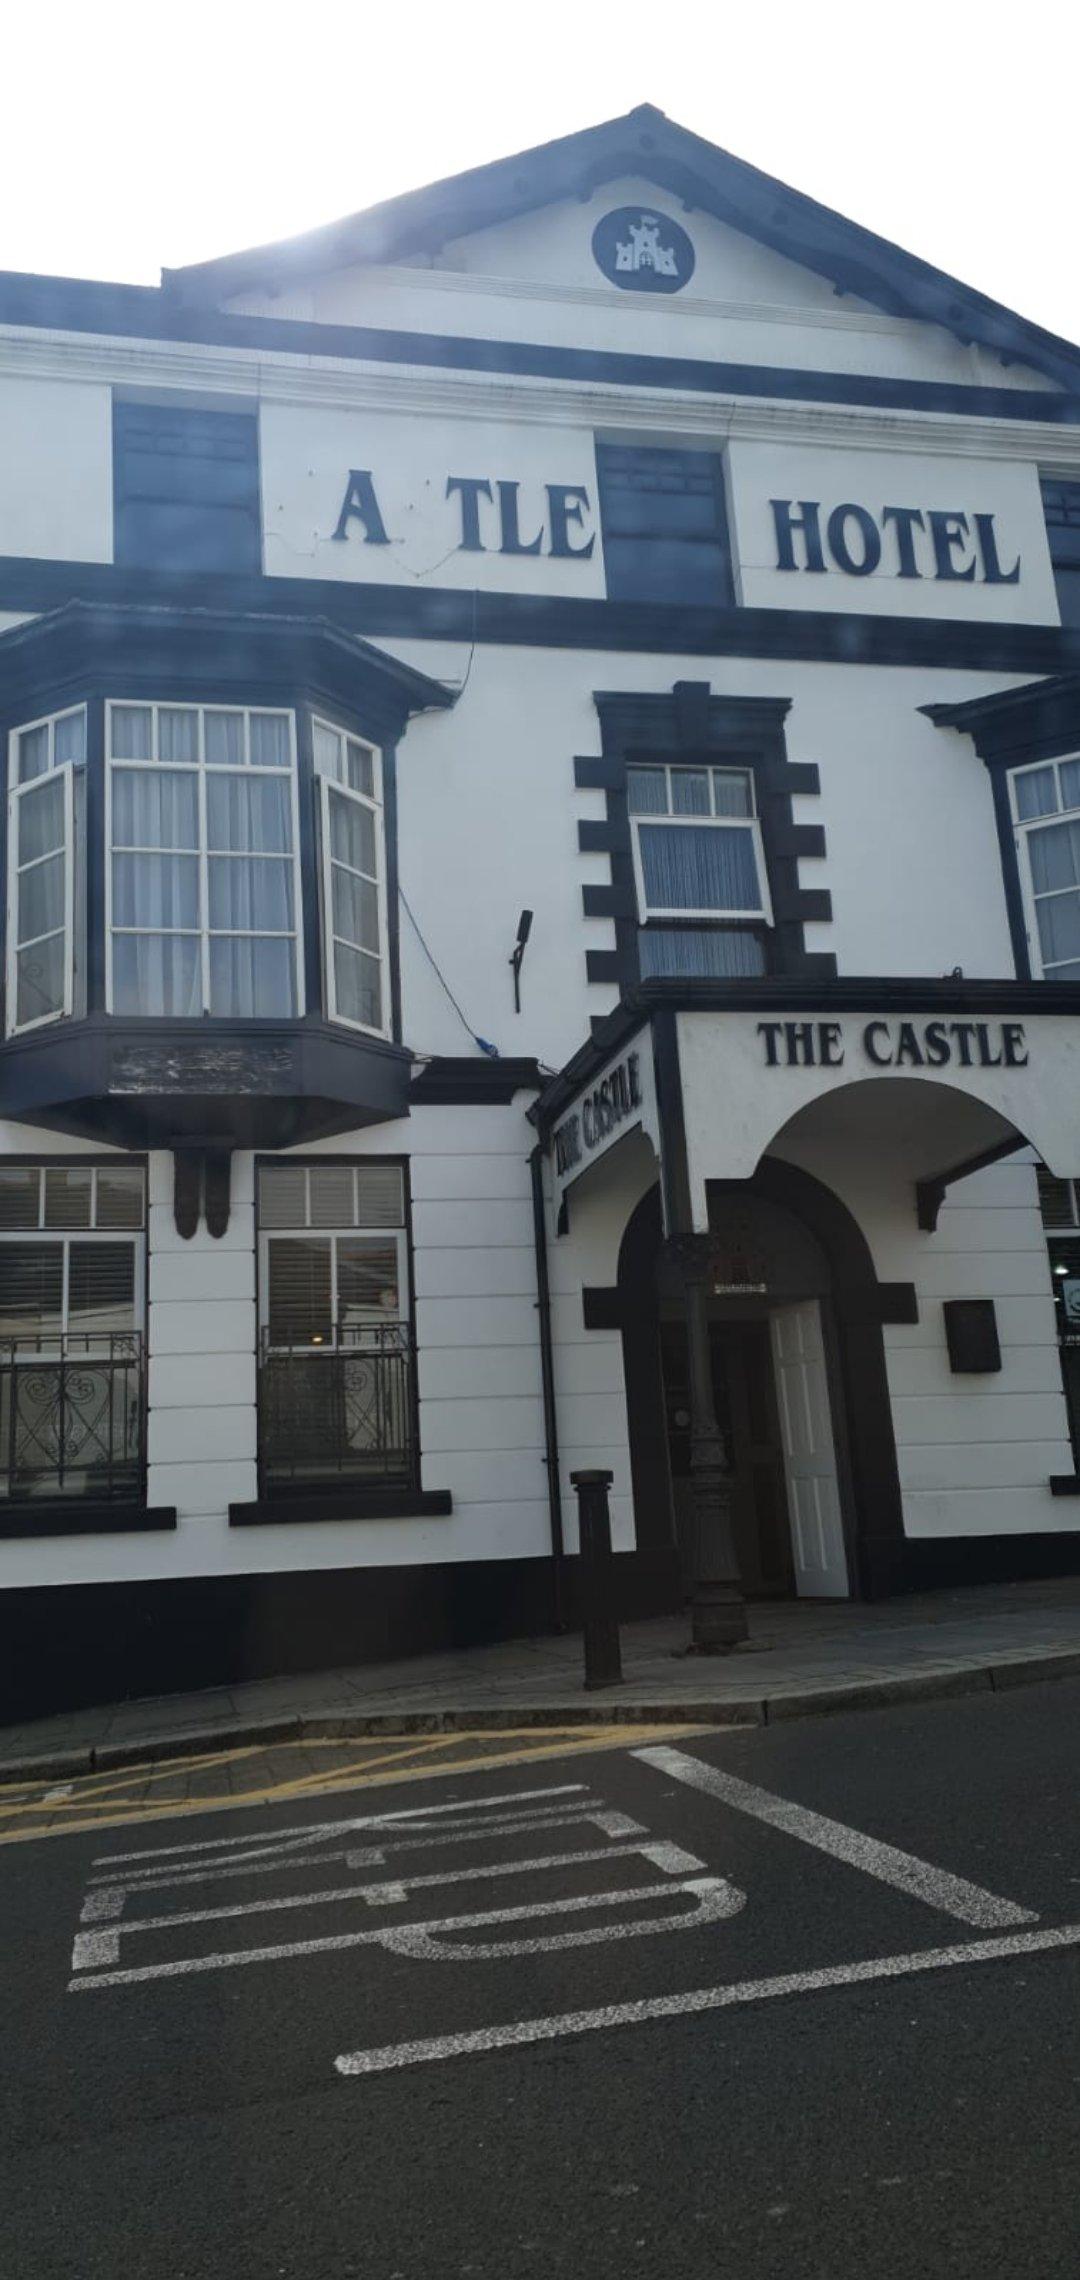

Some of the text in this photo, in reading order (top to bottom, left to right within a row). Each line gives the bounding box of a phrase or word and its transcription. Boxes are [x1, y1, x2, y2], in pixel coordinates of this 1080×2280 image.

[768, 498, 1022, 584] HOTEL
[757, 1020, 1029, 1067] THE CASTLE
[554, 1051, 643, 1178] THE CASTLE
[66, 1783, 748, 1993] KEEP
